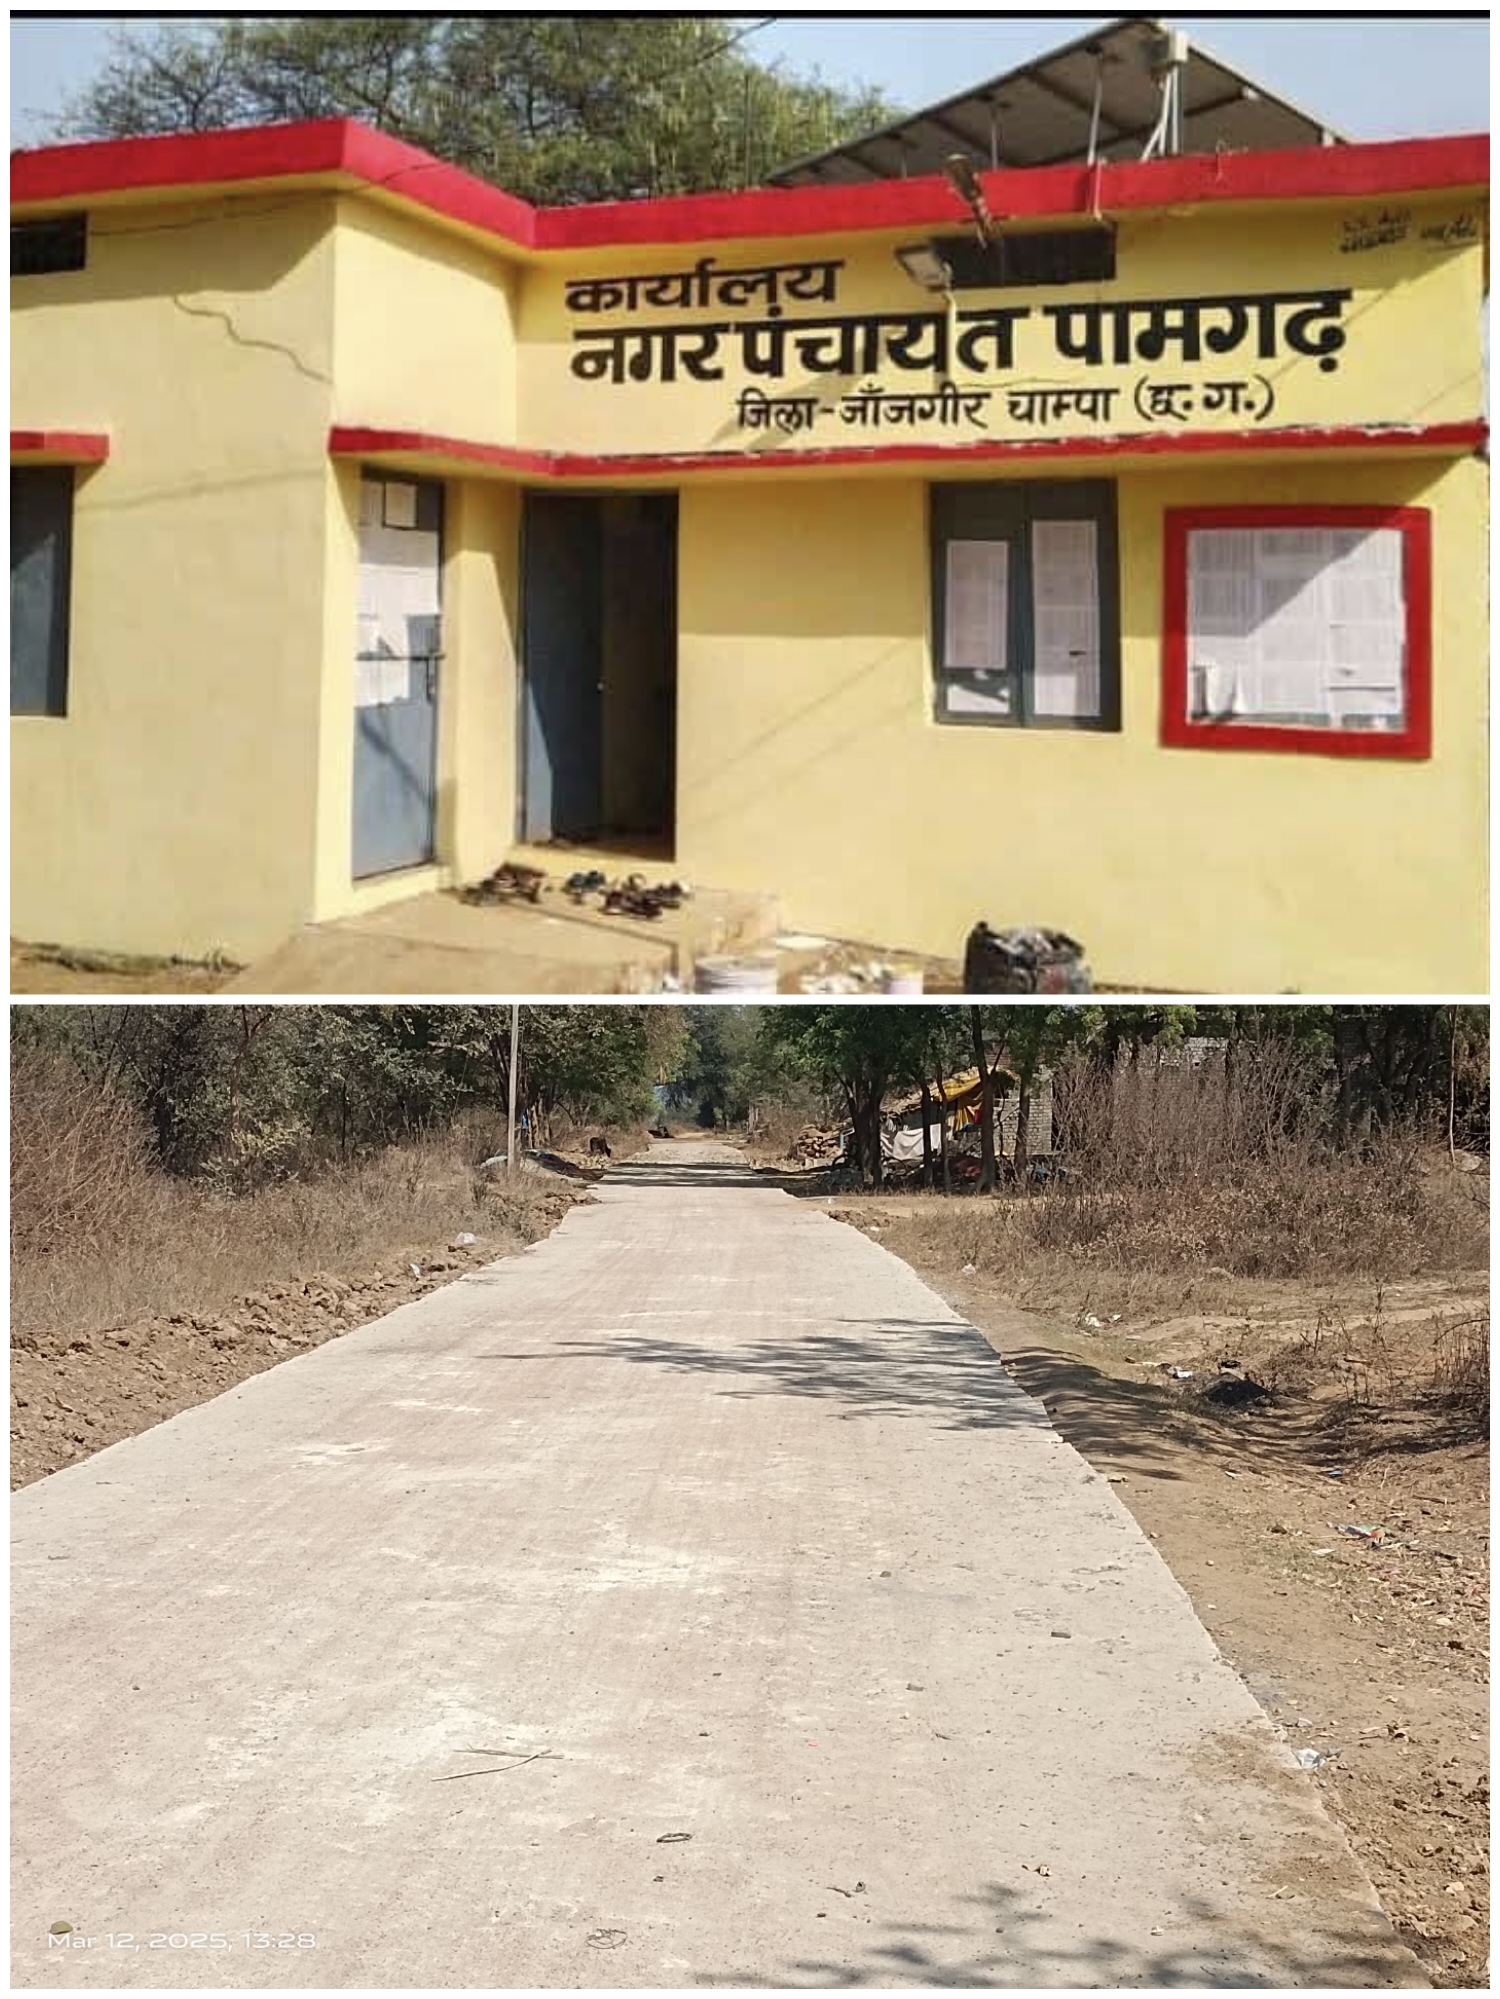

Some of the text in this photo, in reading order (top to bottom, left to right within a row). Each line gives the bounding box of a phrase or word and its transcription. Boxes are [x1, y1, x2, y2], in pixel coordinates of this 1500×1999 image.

[565, 258, 845, 313] कार्यालय
[571, 288, 1353, 384] नगर पंचायत पामगढ़
[1008, 388, 1120, 424] चाम्पा
